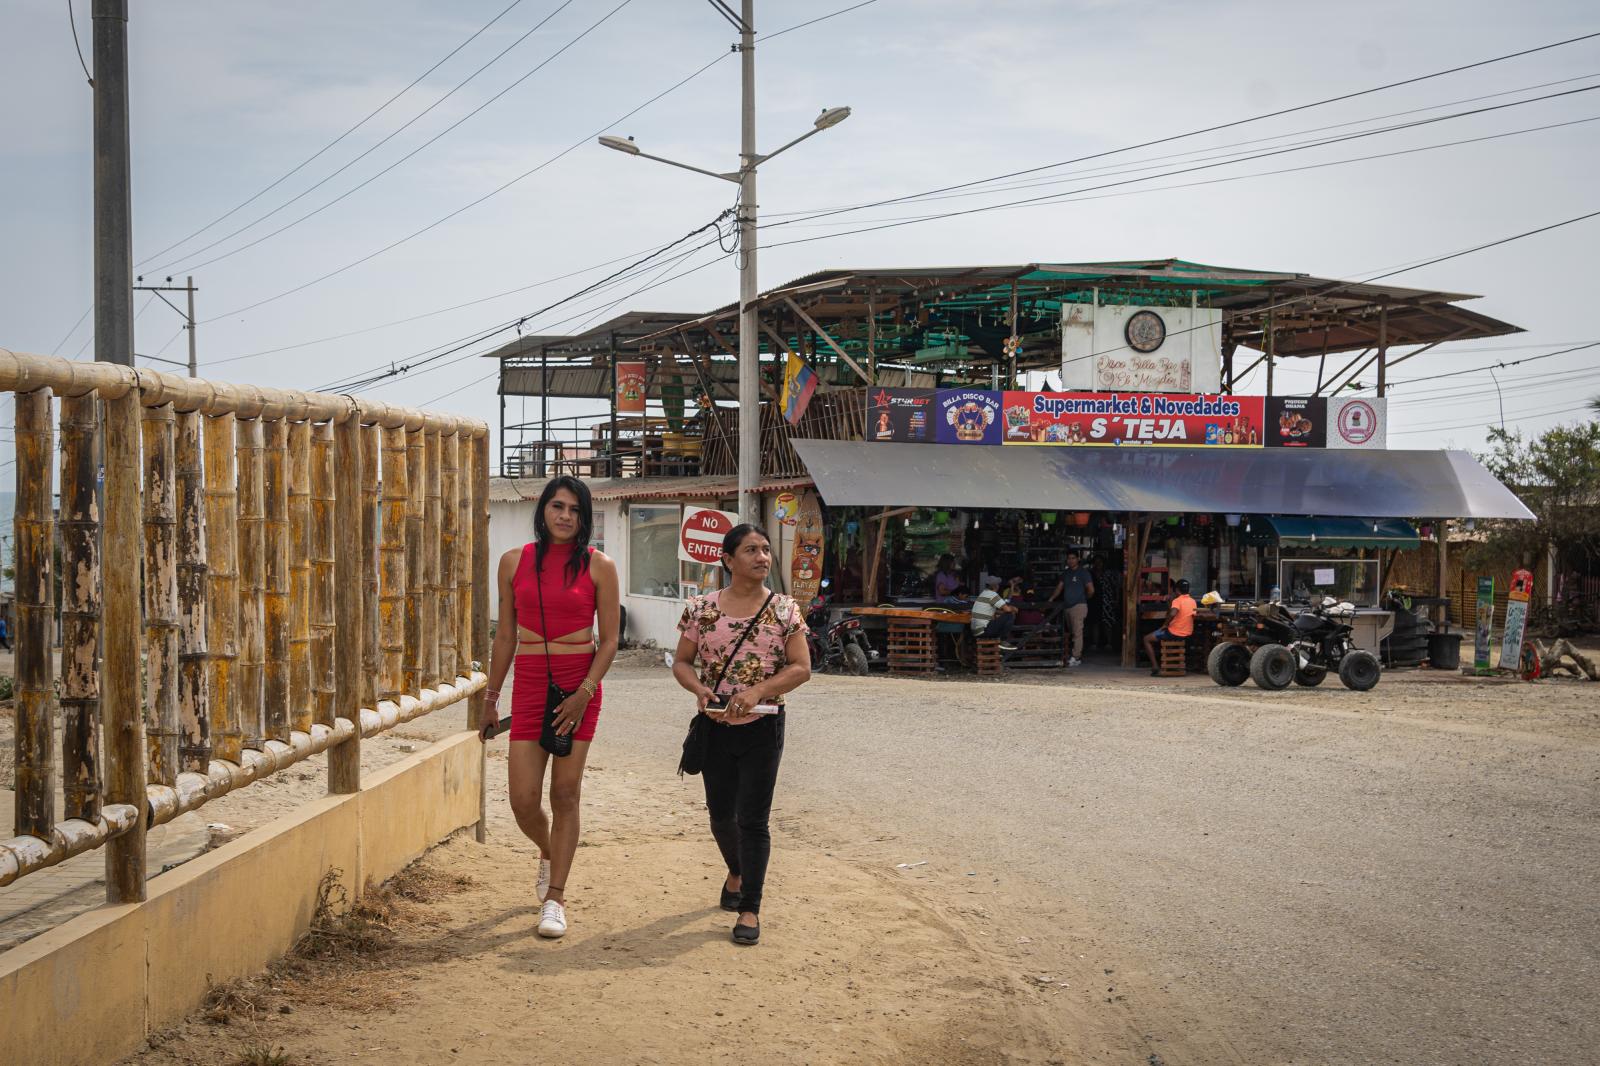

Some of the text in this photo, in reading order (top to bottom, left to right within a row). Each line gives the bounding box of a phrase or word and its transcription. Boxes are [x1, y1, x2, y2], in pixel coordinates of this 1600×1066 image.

[962, 393, 985, 401] DISCO
[985, 397, 1000, 410] BAR
[1033, 394, 1240, 419] Supermarket & Novedades
[702, 517, 718, 529] NO
[687, 542, 723, 558] ENTRE
